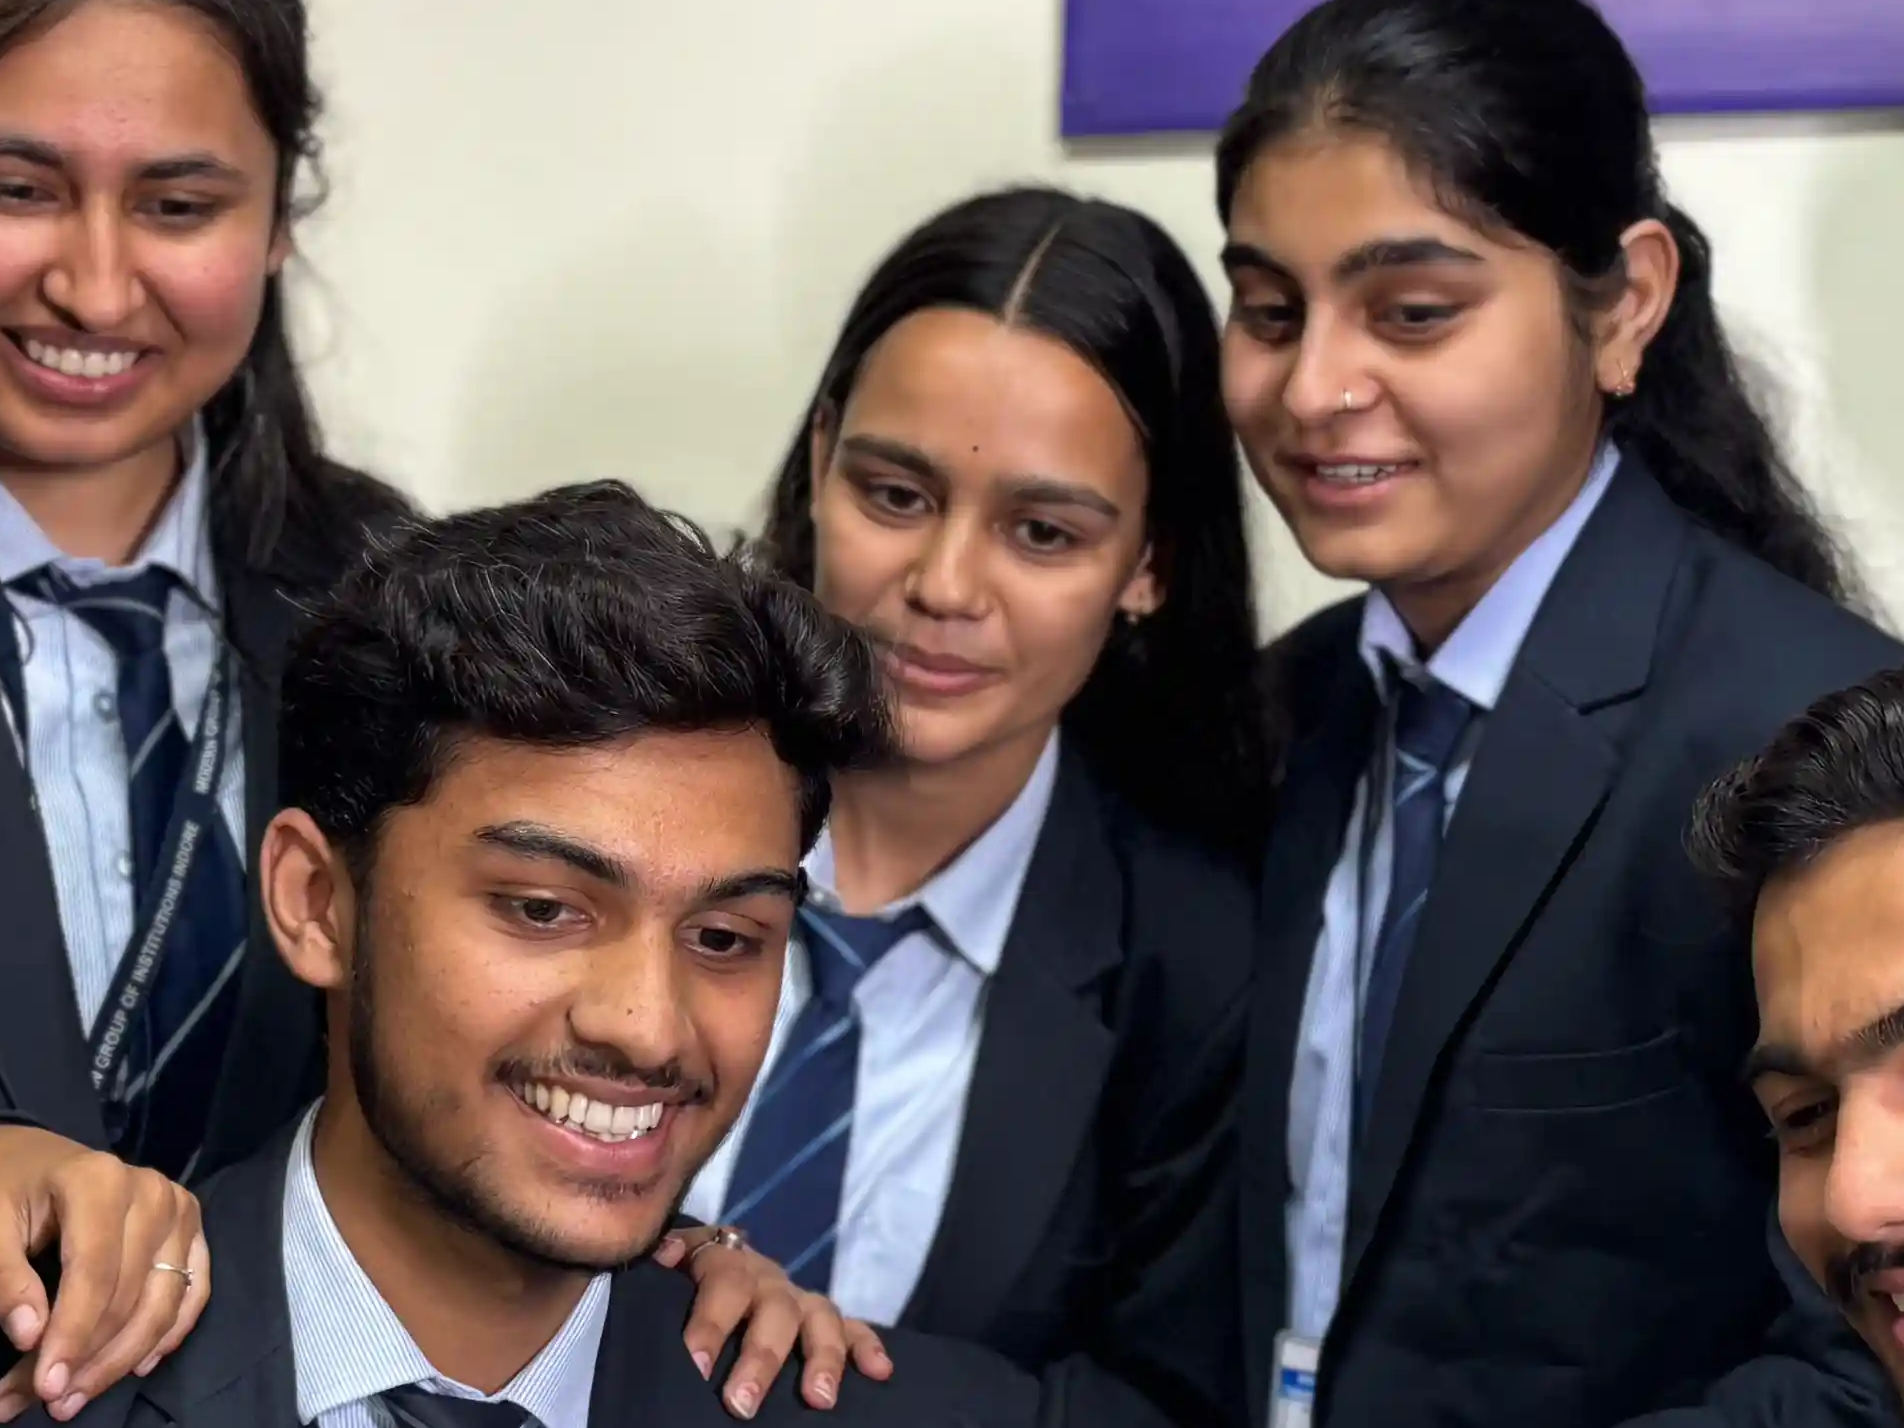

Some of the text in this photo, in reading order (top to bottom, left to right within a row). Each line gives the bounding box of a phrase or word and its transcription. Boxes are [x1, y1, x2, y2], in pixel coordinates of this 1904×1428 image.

[96, 1009, 128, 1073] GROUP
[122, 983, 140, 1010] OF
[132, 876, 182, 984] INSTITUTIONS
[173, 820, 200, 875] INDORE
